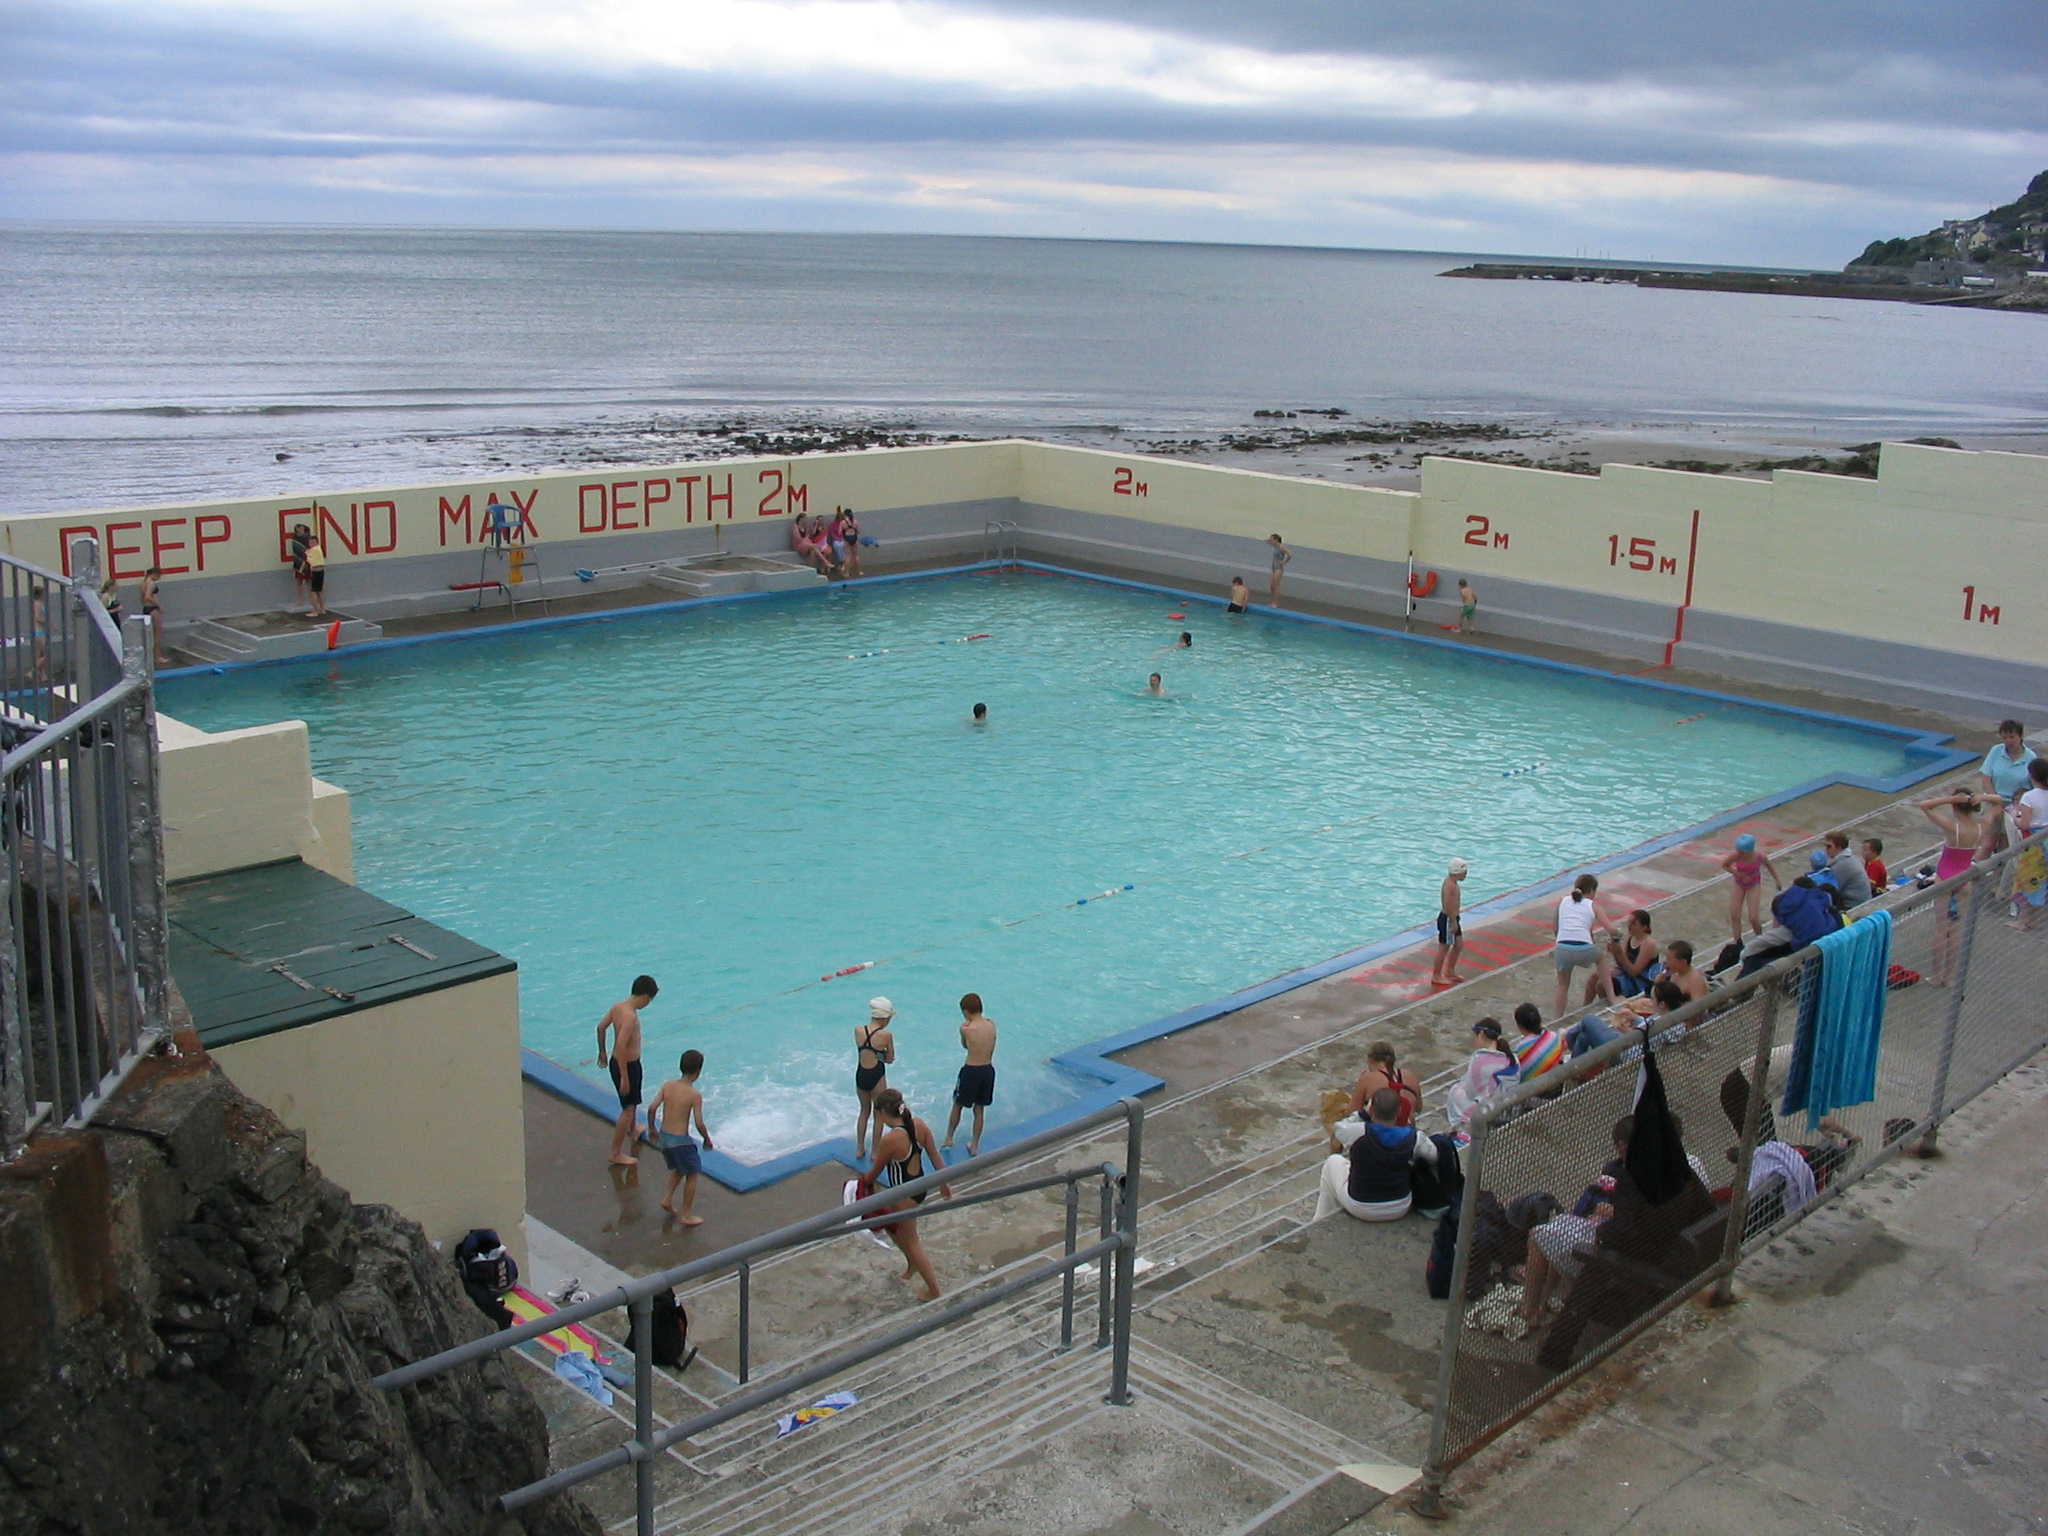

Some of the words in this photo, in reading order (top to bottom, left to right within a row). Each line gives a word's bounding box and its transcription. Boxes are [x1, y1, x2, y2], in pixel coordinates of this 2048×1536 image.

[59, 513, 232, 579] DEEP
[278, 500, 398, 563] END
[438, 488, 540, 547] MAX
[578, 475, 734, 534] DEPTH
